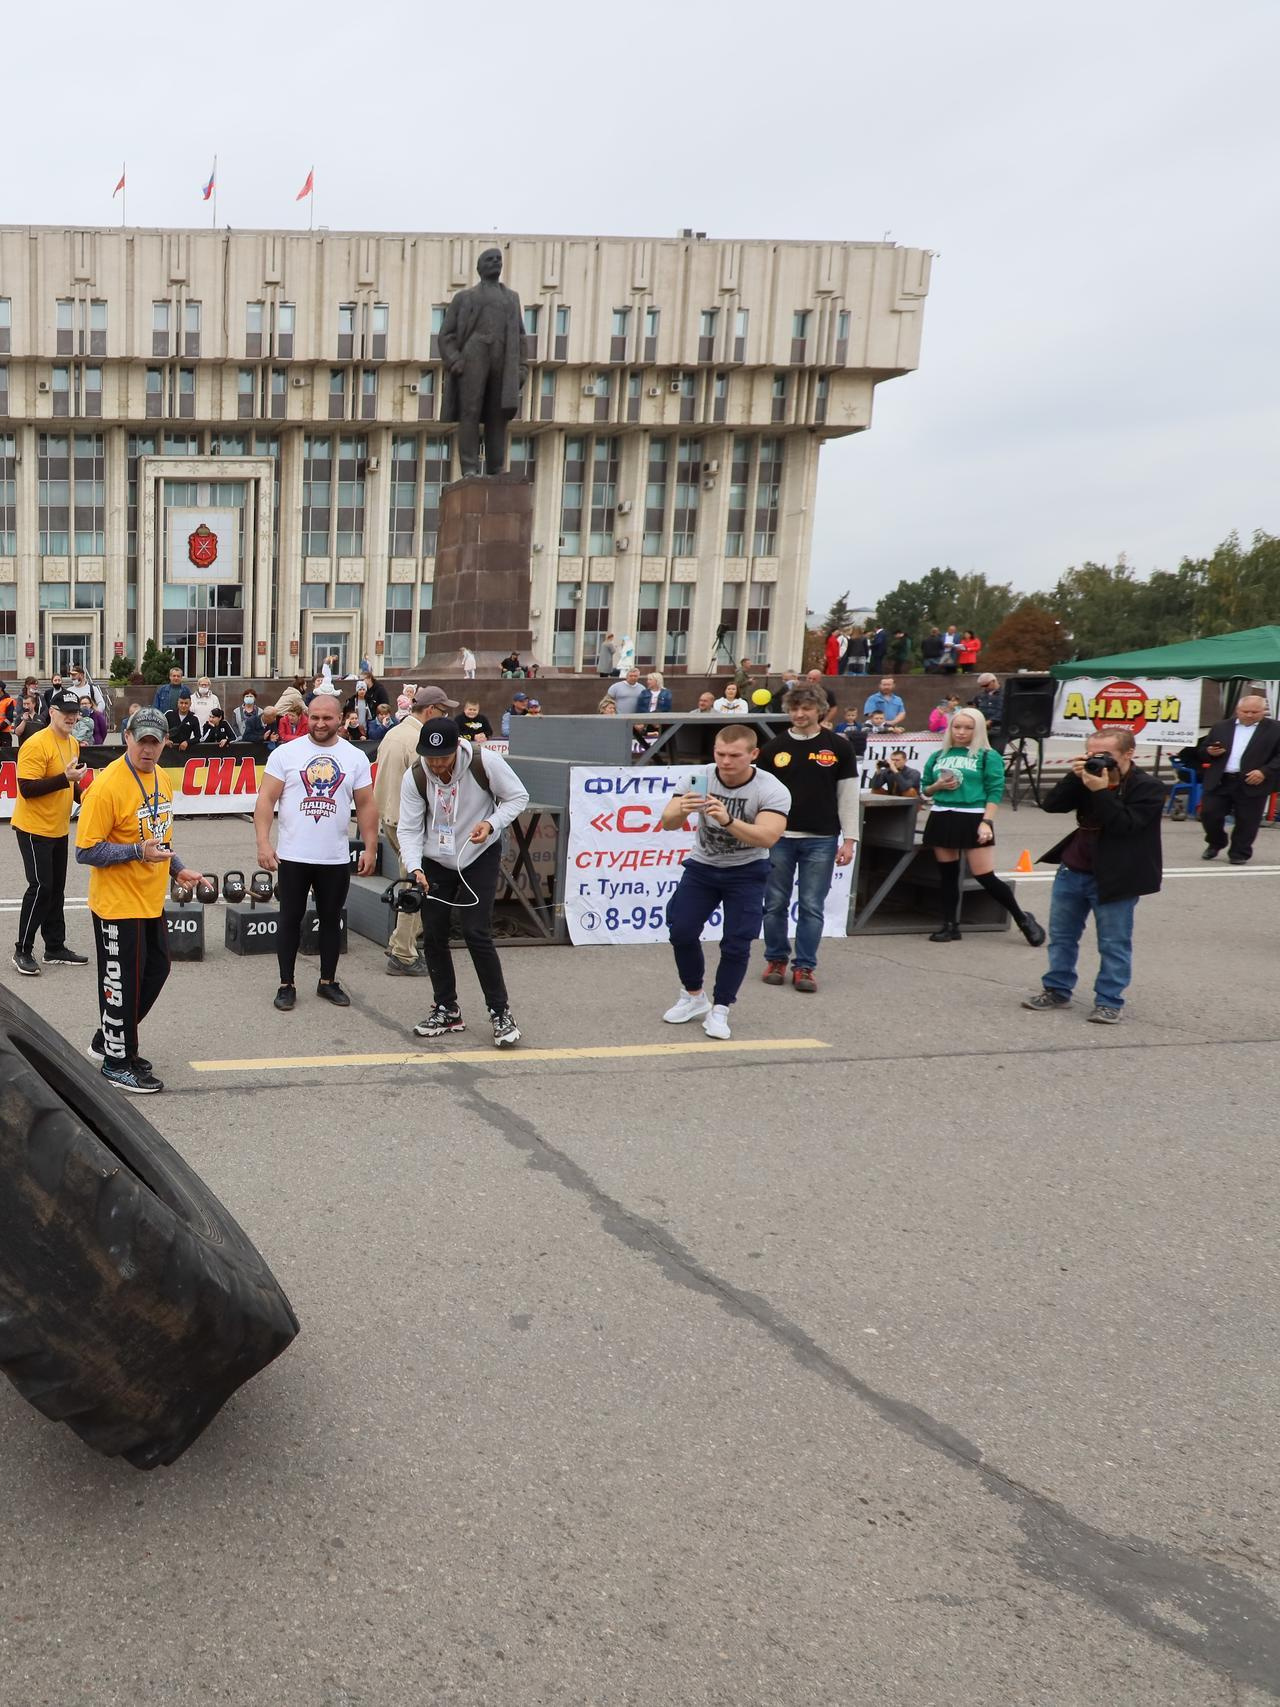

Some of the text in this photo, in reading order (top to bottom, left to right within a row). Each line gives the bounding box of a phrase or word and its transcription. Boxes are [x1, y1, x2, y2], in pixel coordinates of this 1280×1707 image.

[182, 757, 260, 796] СИЛ
[300, 801, 337, 814] НАЦИЯ
[305, 809, 330, 817] МИРА
[232, 882, 243, 891] 32
[580, 883, 591, 895] г.
[598, 879, 650, 900] Тула,
[247, 921, 278, 936] 200
[102, 1009, 127, 1059] GET
